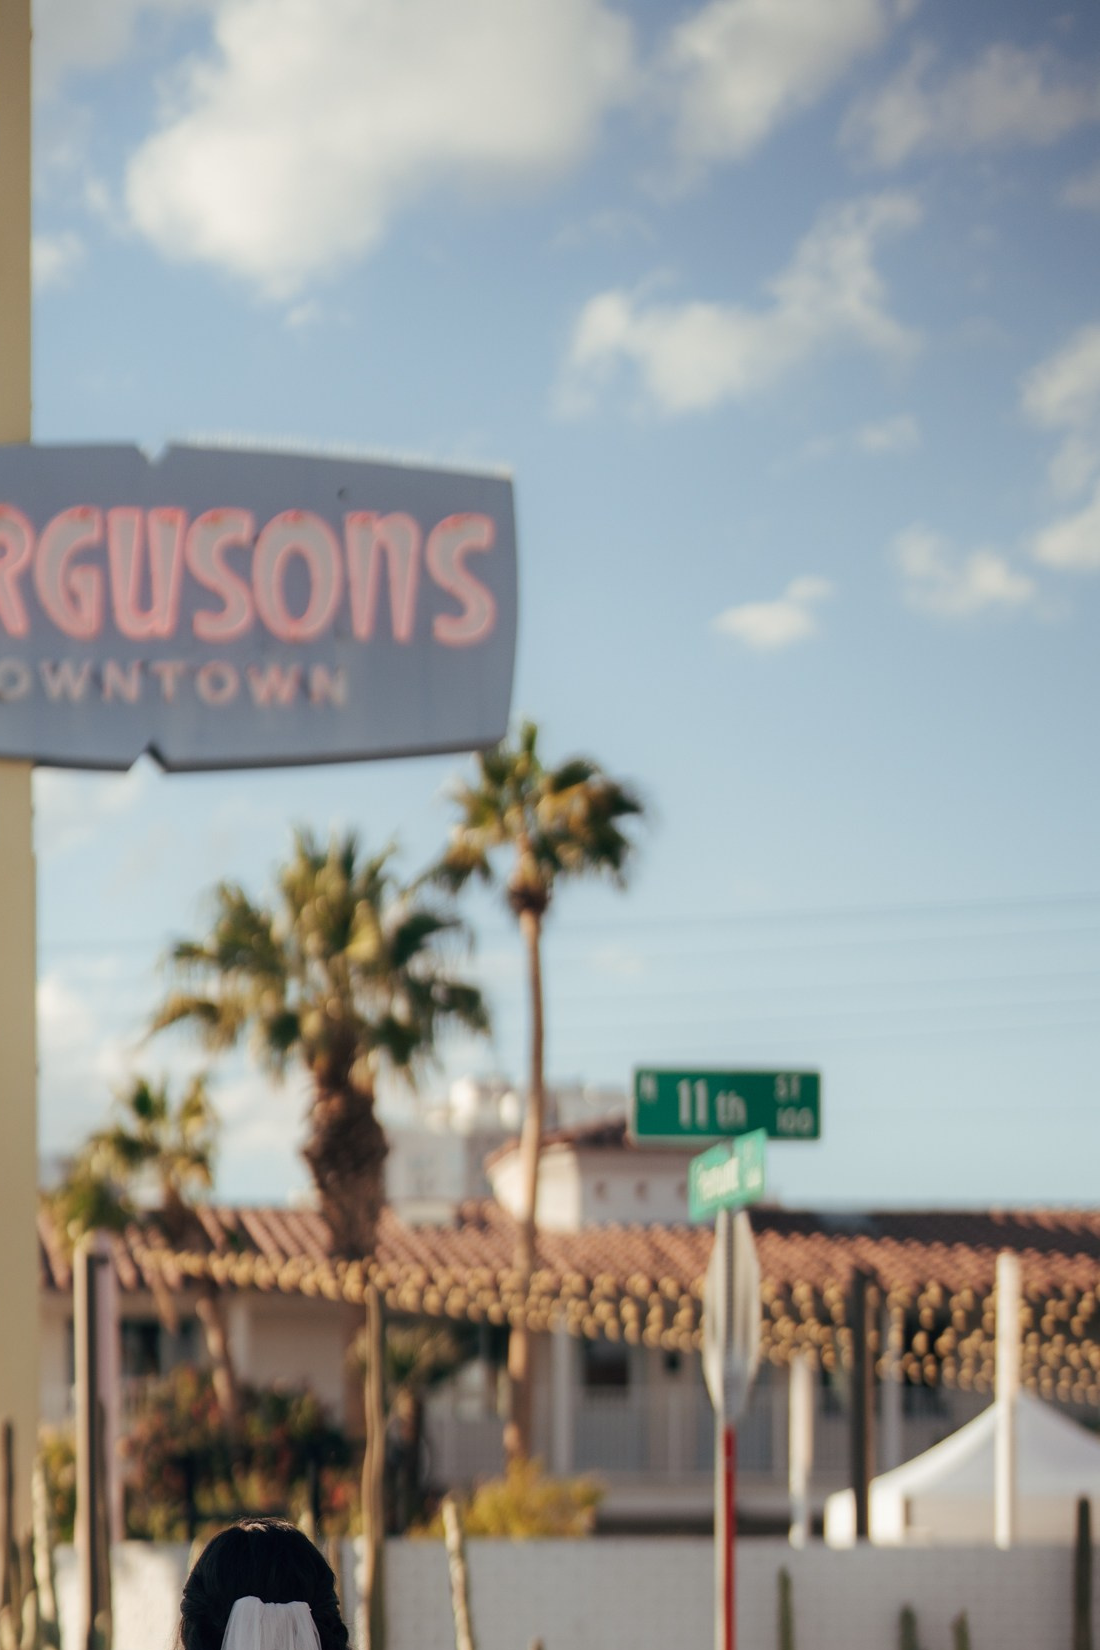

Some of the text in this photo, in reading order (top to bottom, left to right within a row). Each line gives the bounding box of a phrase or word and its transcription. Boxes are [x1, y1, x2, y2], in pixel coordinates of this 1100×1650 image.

[677, 1078, 747, 1130] 11th
[774, 1073, 800, 1102] ST
[776, 1106, 814, 1135] 100
